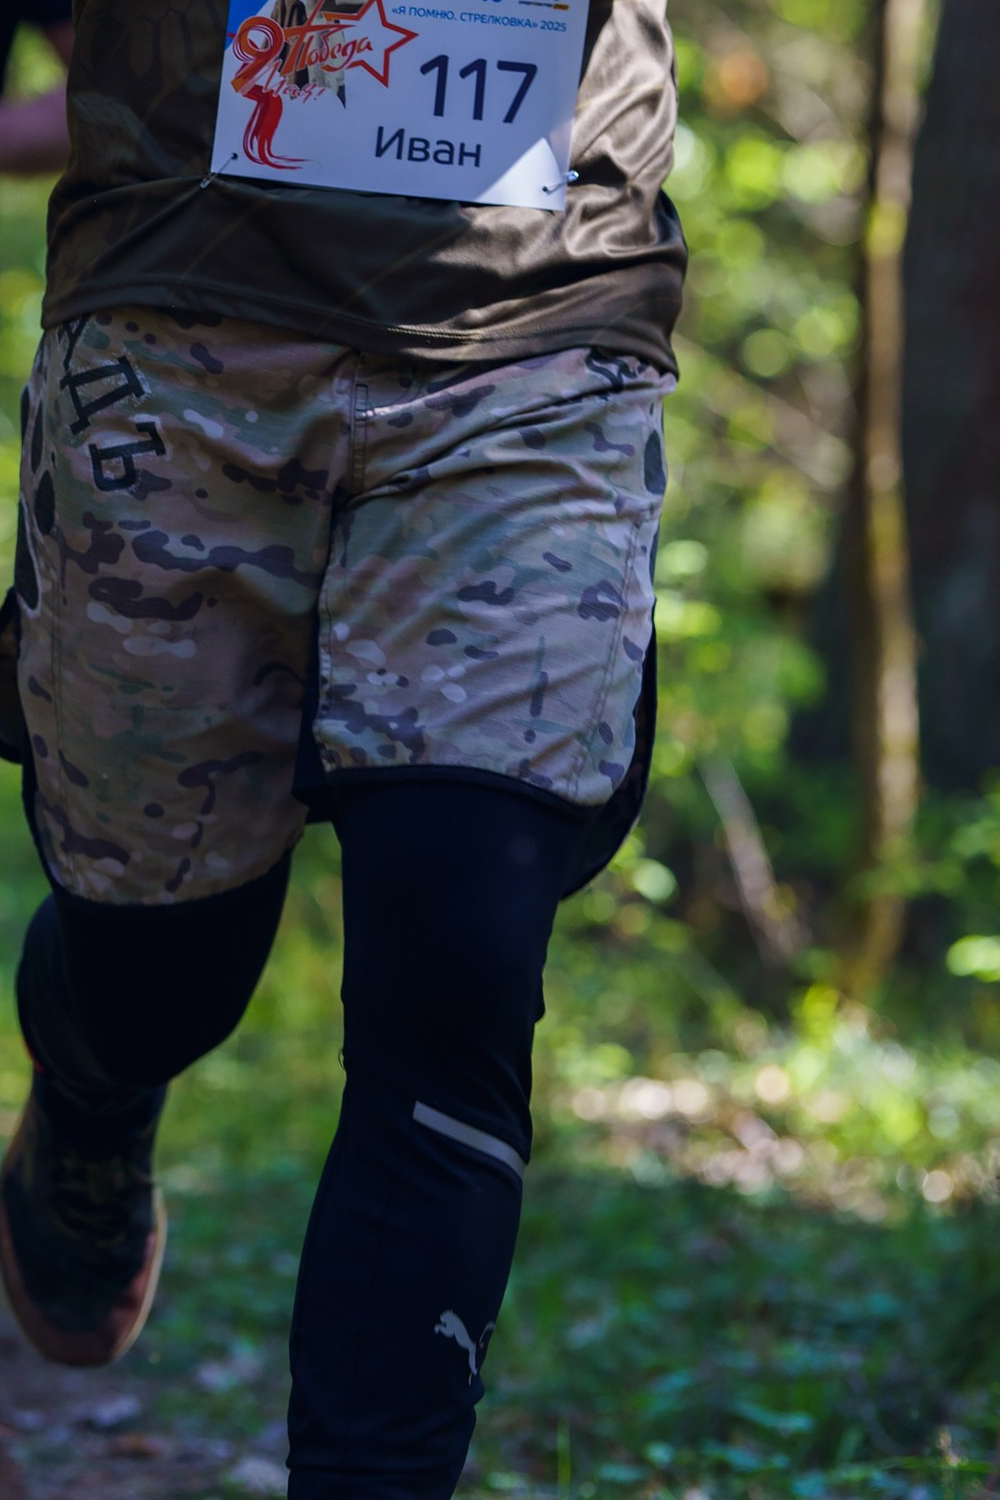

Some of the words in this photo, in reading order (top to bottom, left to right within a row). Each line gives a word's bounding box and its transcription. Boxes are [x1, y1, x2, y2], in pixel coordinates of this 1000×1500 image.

[392, 5, 406, 15] «Я
[409, 7, 457, 21] ПОМНЮ.
[460, 12, 538, 29] СТРЕЛКОВКА»
[540, 20, 567, 32] 2025
[419, 54, 538, 124] 117
[374, 126, 482, 168] Иван
